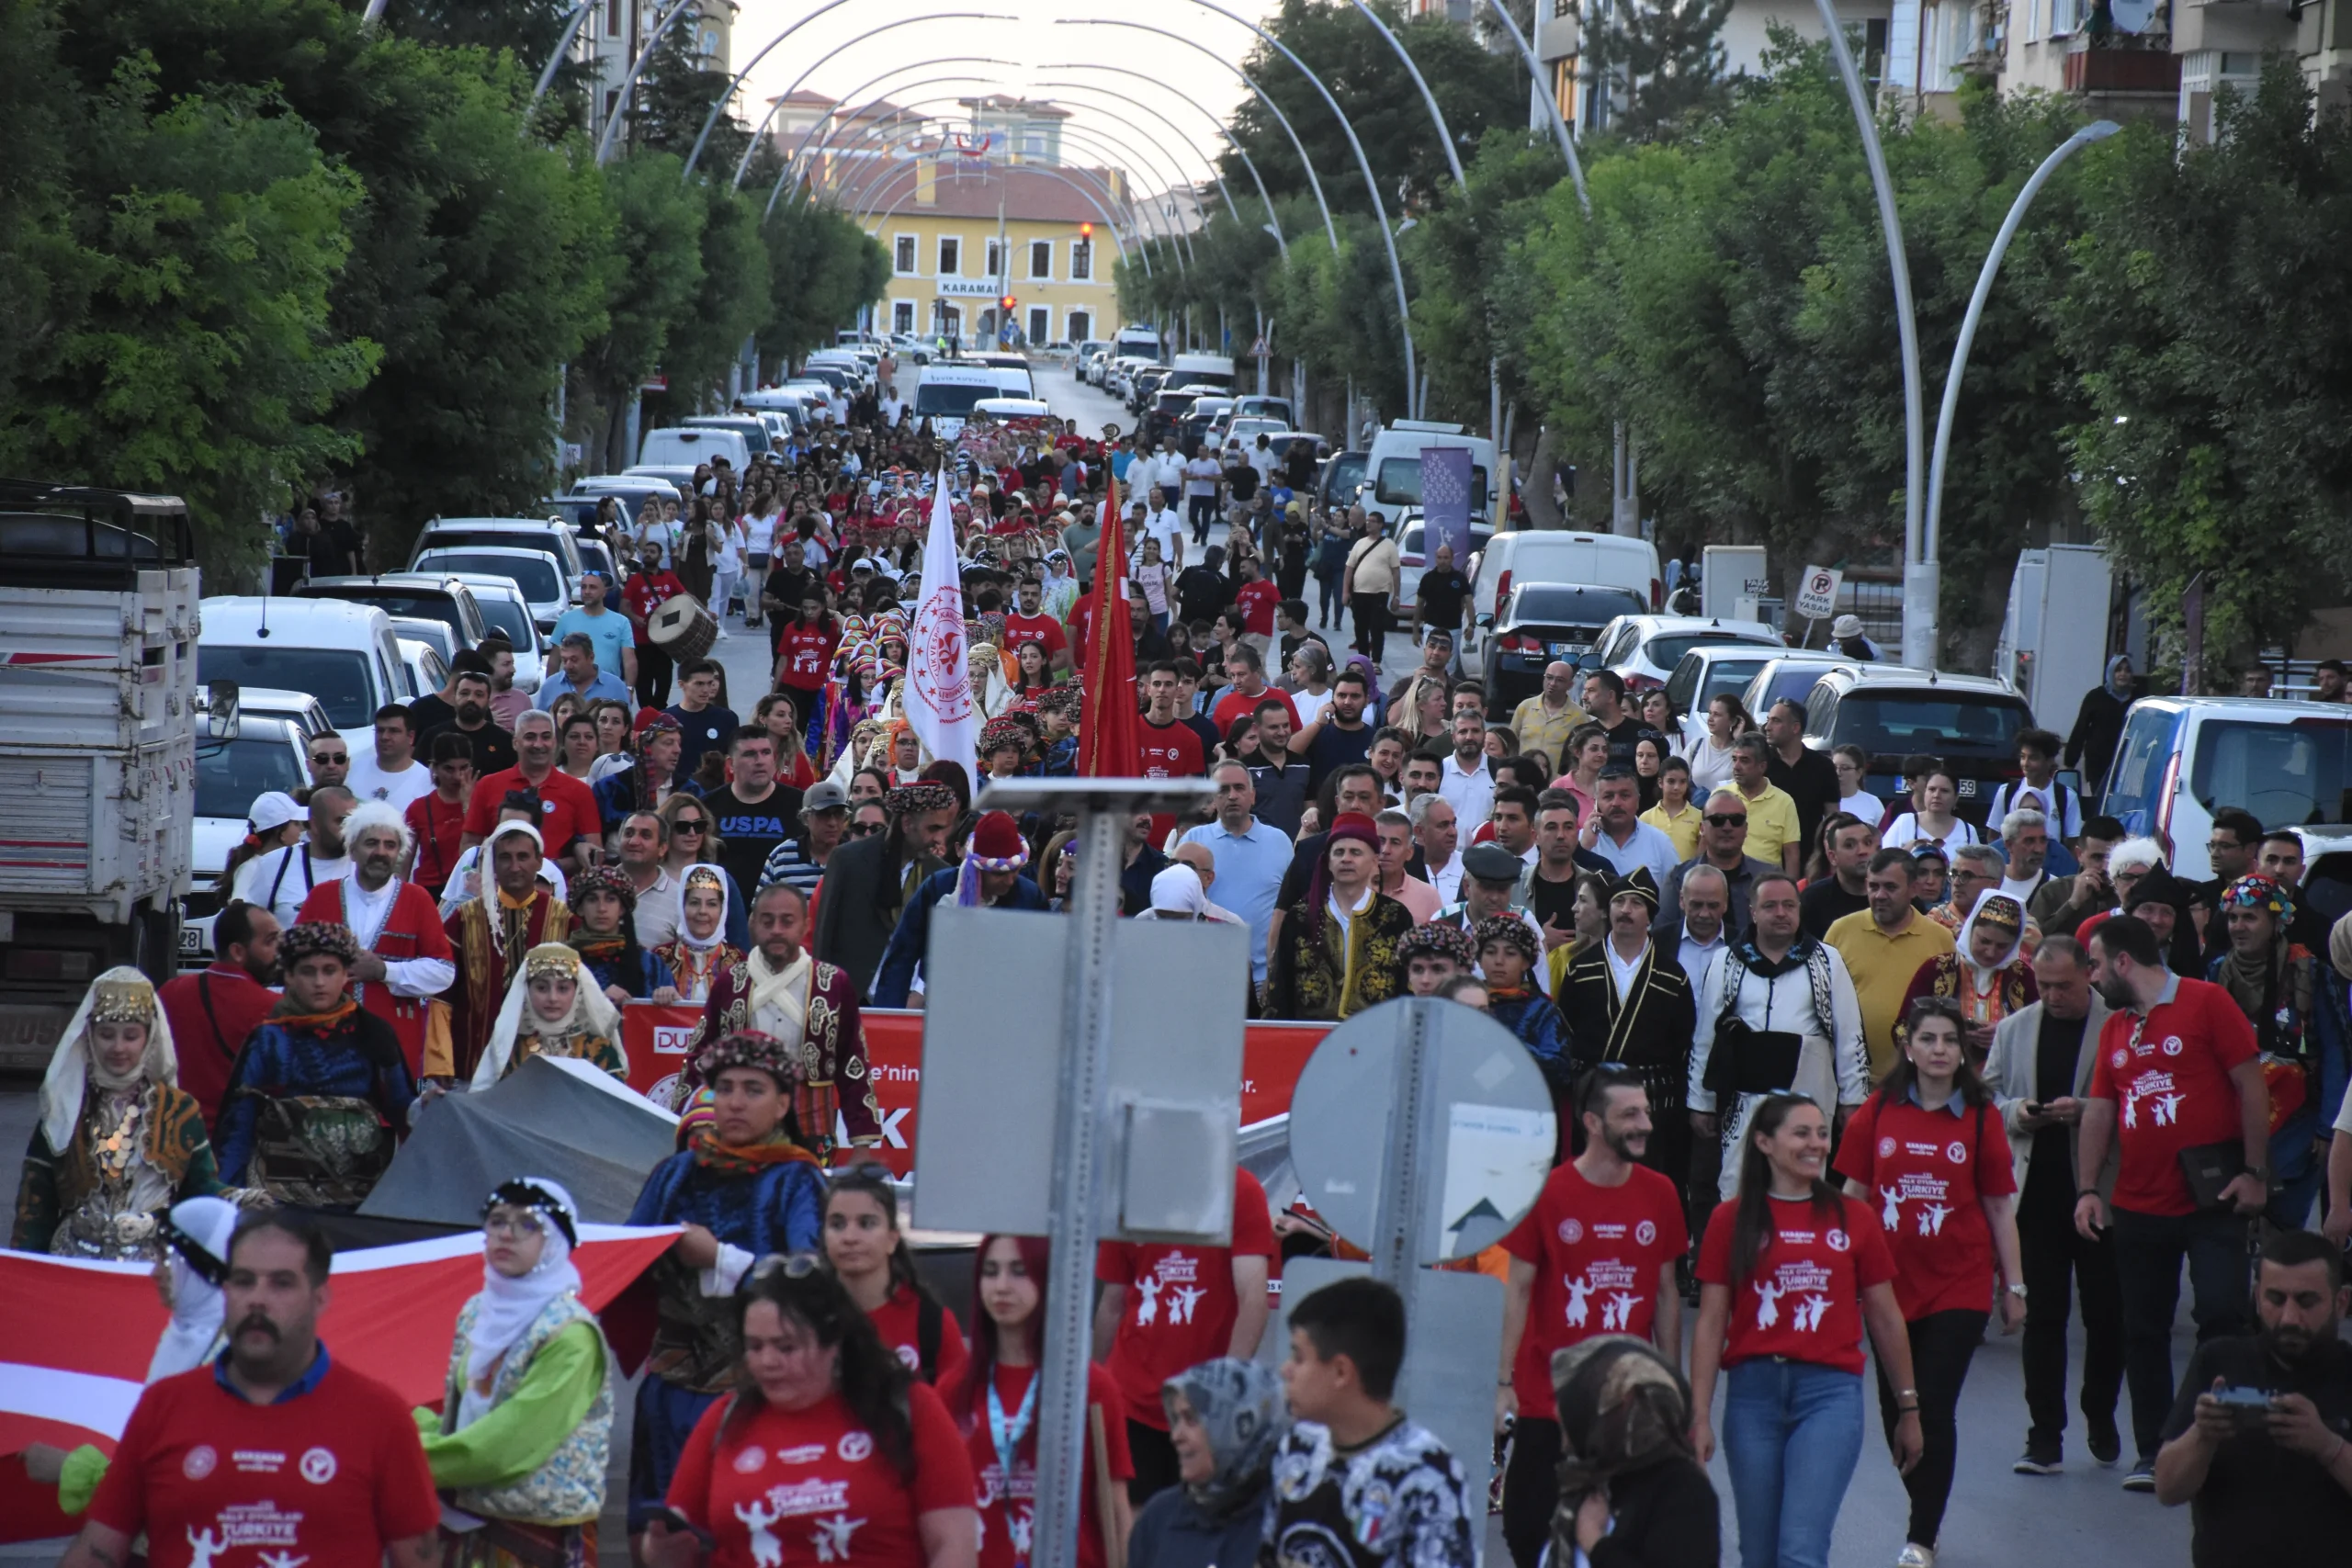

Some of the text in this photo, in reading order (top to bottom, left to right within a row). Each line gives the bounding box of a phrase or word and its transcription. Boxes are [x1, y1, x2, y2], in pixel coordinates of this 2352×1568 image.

[1804, 592, 1830, 604] PARK
[1799, 601, 1831, 614] YASAK
[1961, 781, 1974, 794] 59
[719, 816, 784, 833] USPA
